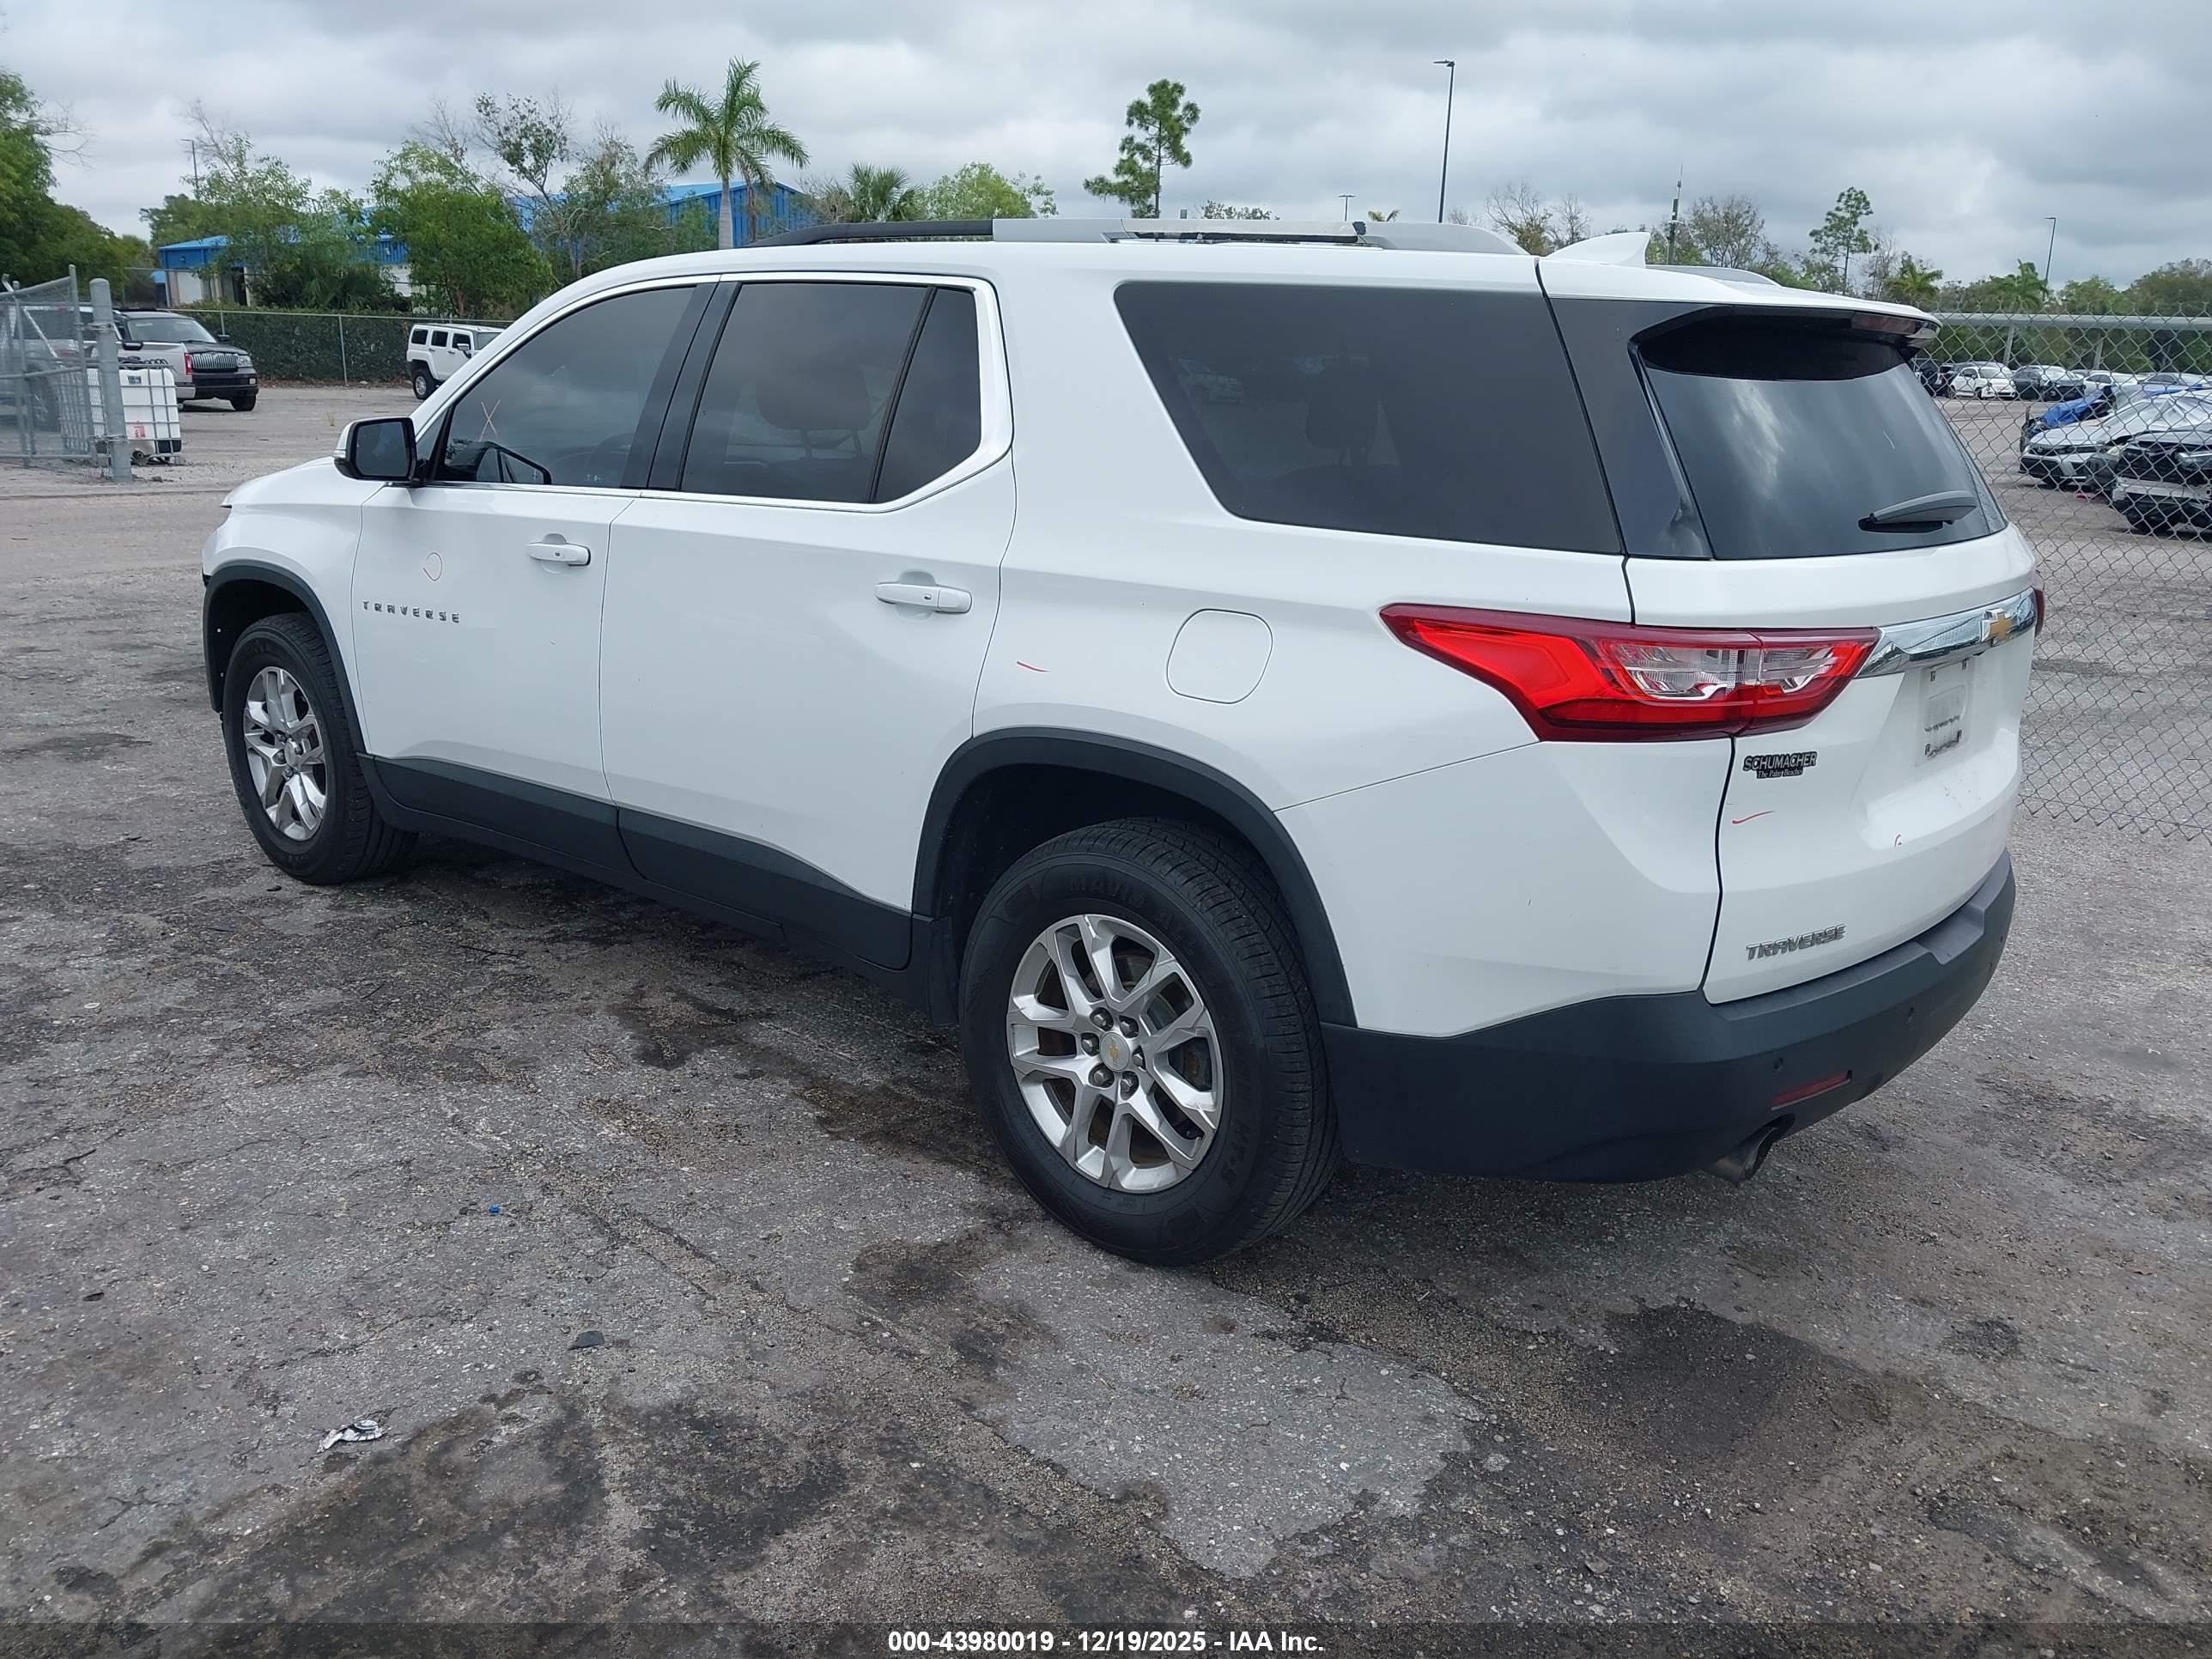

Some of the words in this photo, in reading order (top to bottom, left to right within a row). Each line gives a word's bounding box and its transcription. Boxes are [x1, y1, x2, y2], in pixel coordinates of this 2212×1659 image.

[362, 599, 460, 624] TRAVERSE
[1743, 753, 1817, 771] SCHUMACHER
[1746, 923, 1847, 960] TRAVERSE
